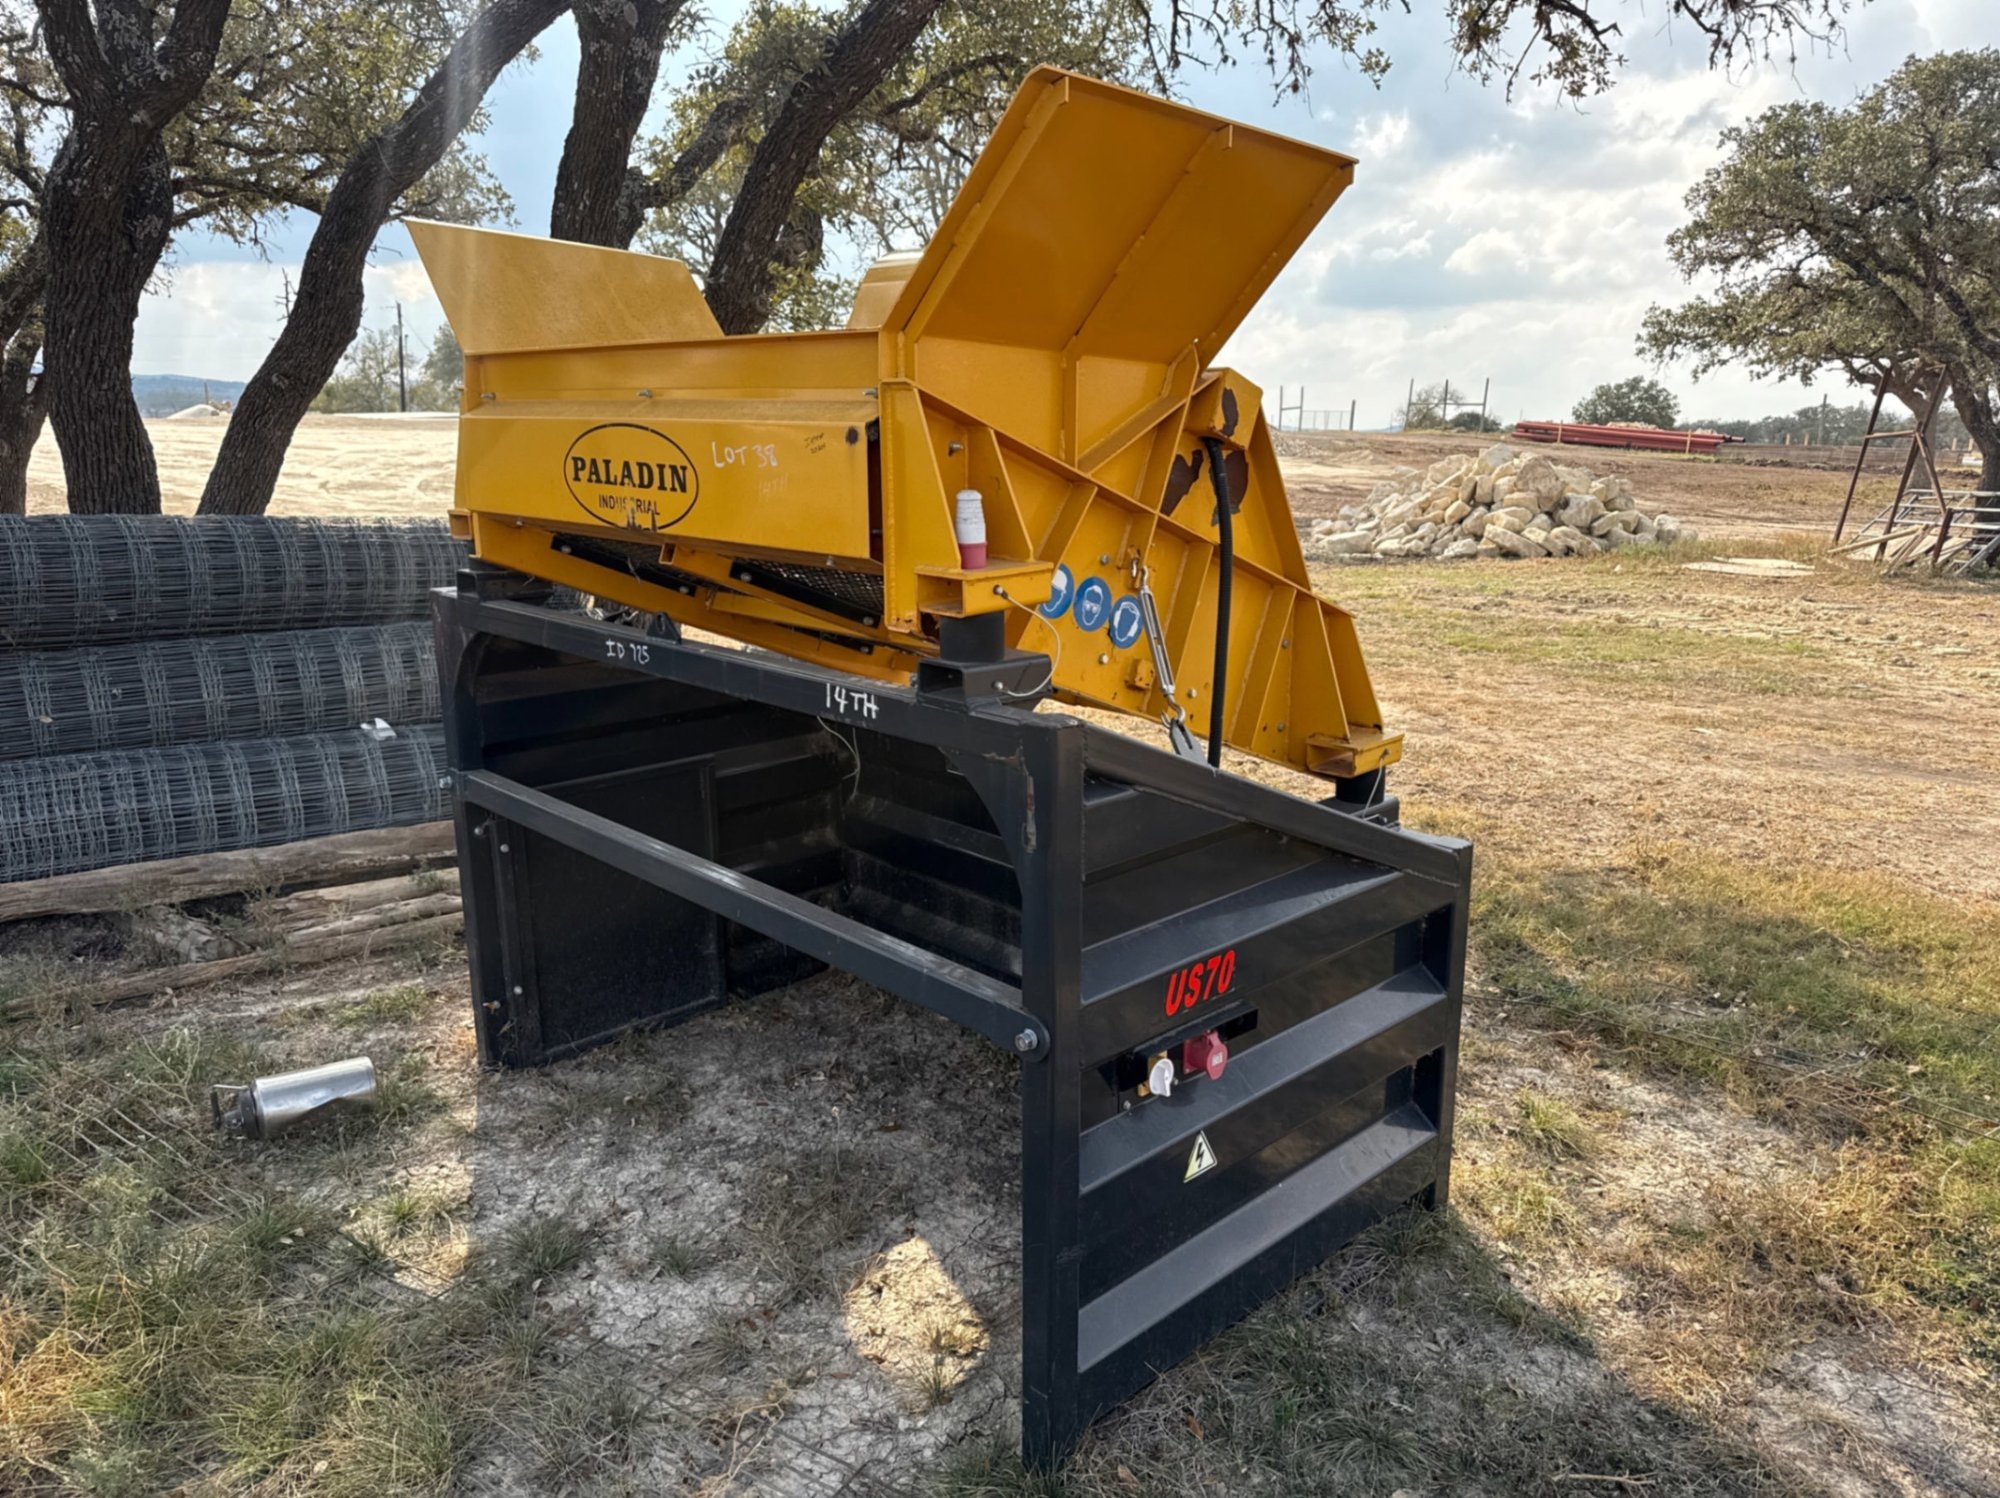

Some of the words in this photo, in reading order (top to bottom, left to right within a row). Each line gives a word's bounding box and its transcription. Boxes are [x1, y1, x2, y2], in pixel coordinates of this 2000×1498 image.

[711, 441, 747, 468] LOT
[752, 443, 778, 468] 38
[572, 456, 687, 493] PALADIN
[599, 494, 660, 515] INDUSRIAL
[605, 638, 625, 659] ID
[826, 683, 879, 719] 14TH
[1165, 950, 1235, 1016] US70
